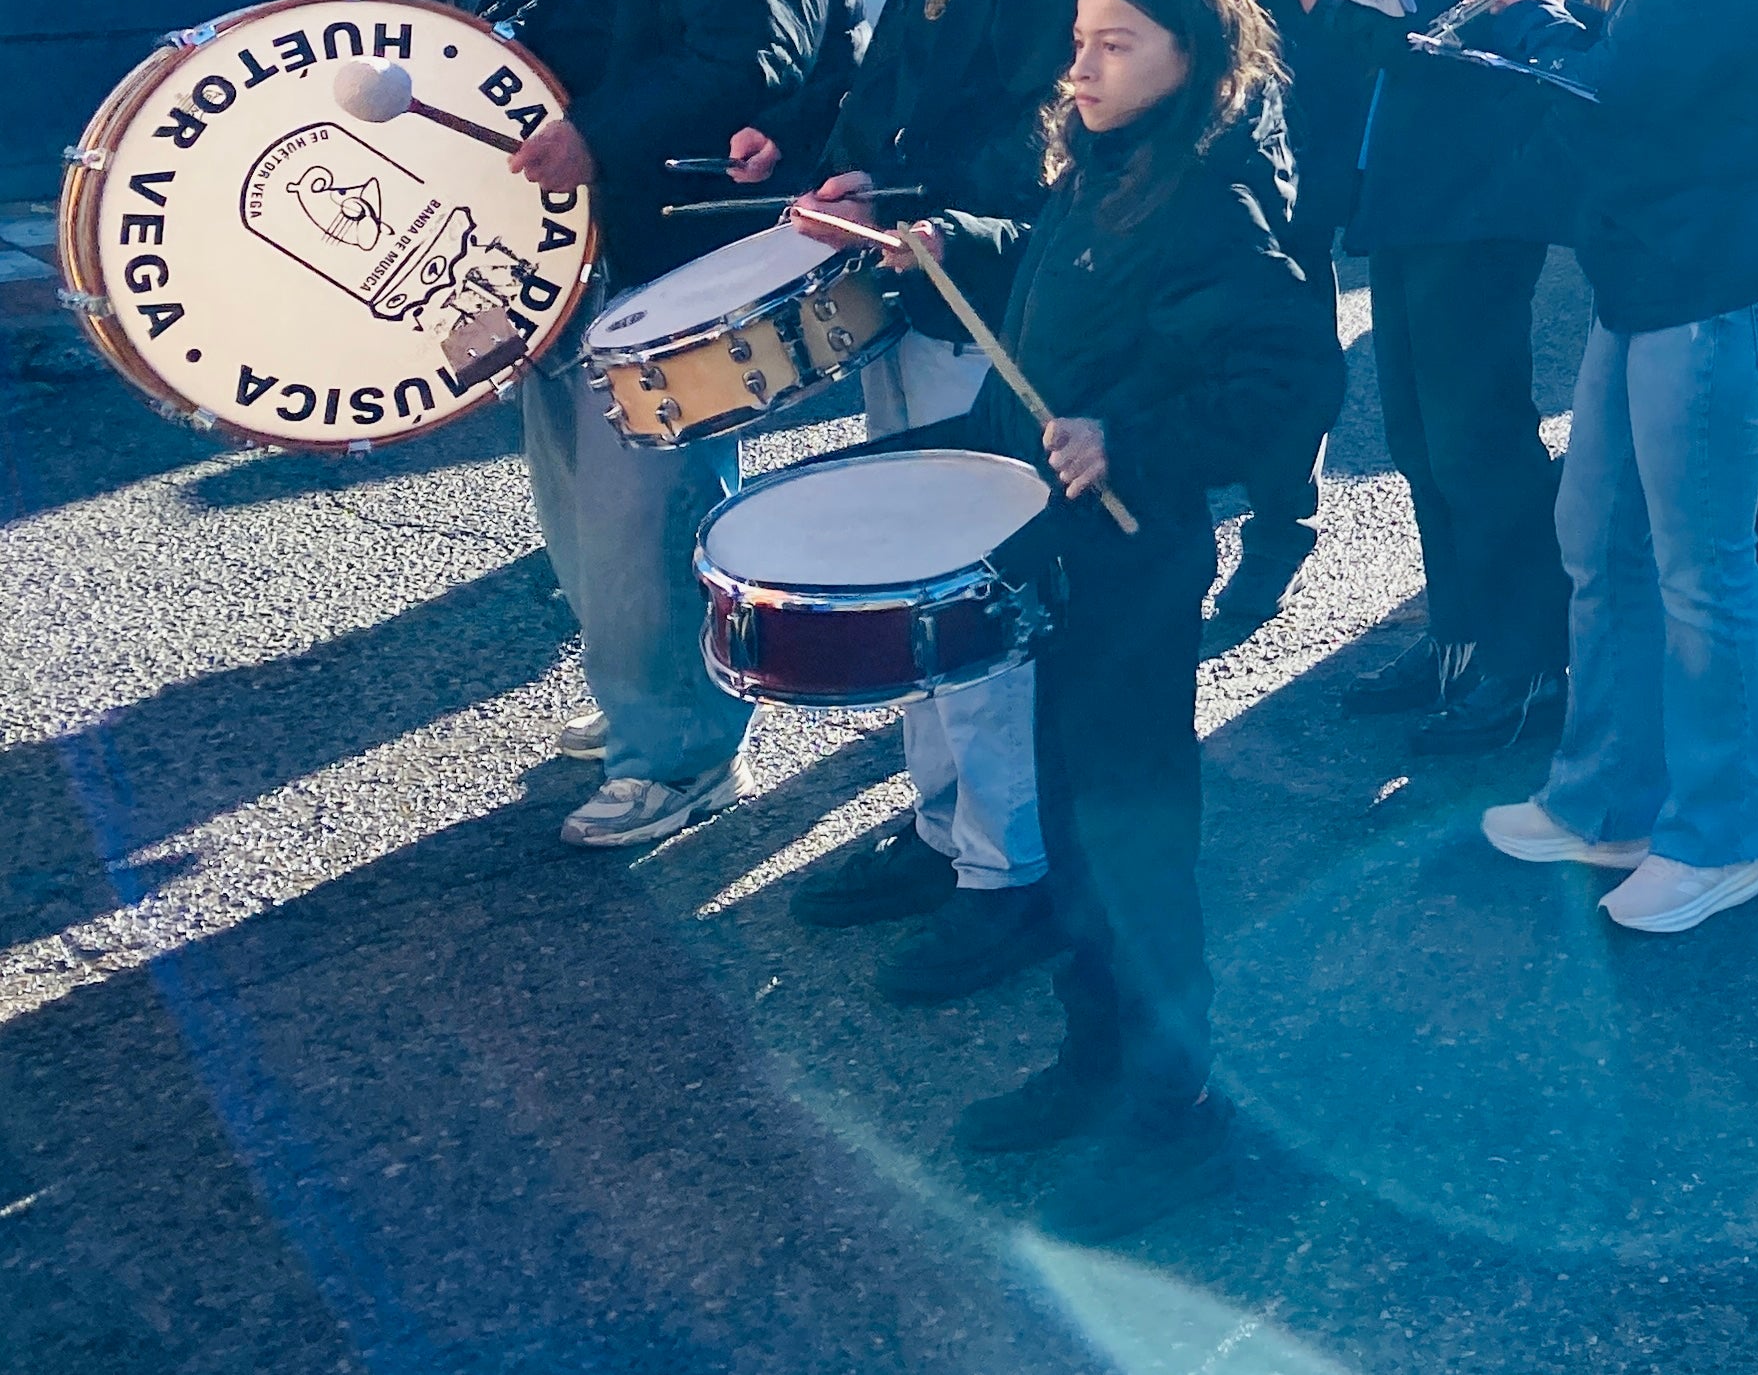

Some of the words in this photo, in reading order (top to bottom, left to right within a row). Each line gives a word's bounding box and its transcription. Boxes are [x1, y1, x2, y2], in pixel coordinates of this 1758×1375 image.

[152, 21, 413, 151] HUÉTOR
[311, 129, 330, 143] DE
[478, 65, 577, 254] BADA
[249, 182, 264, 218] VEGA
[409, 199, 441, 235] BANDA
[119, 169, 186, 340] VEGA
[396, 235, 413, 252] DE
[359, 250, 399, 291] MUSICA
